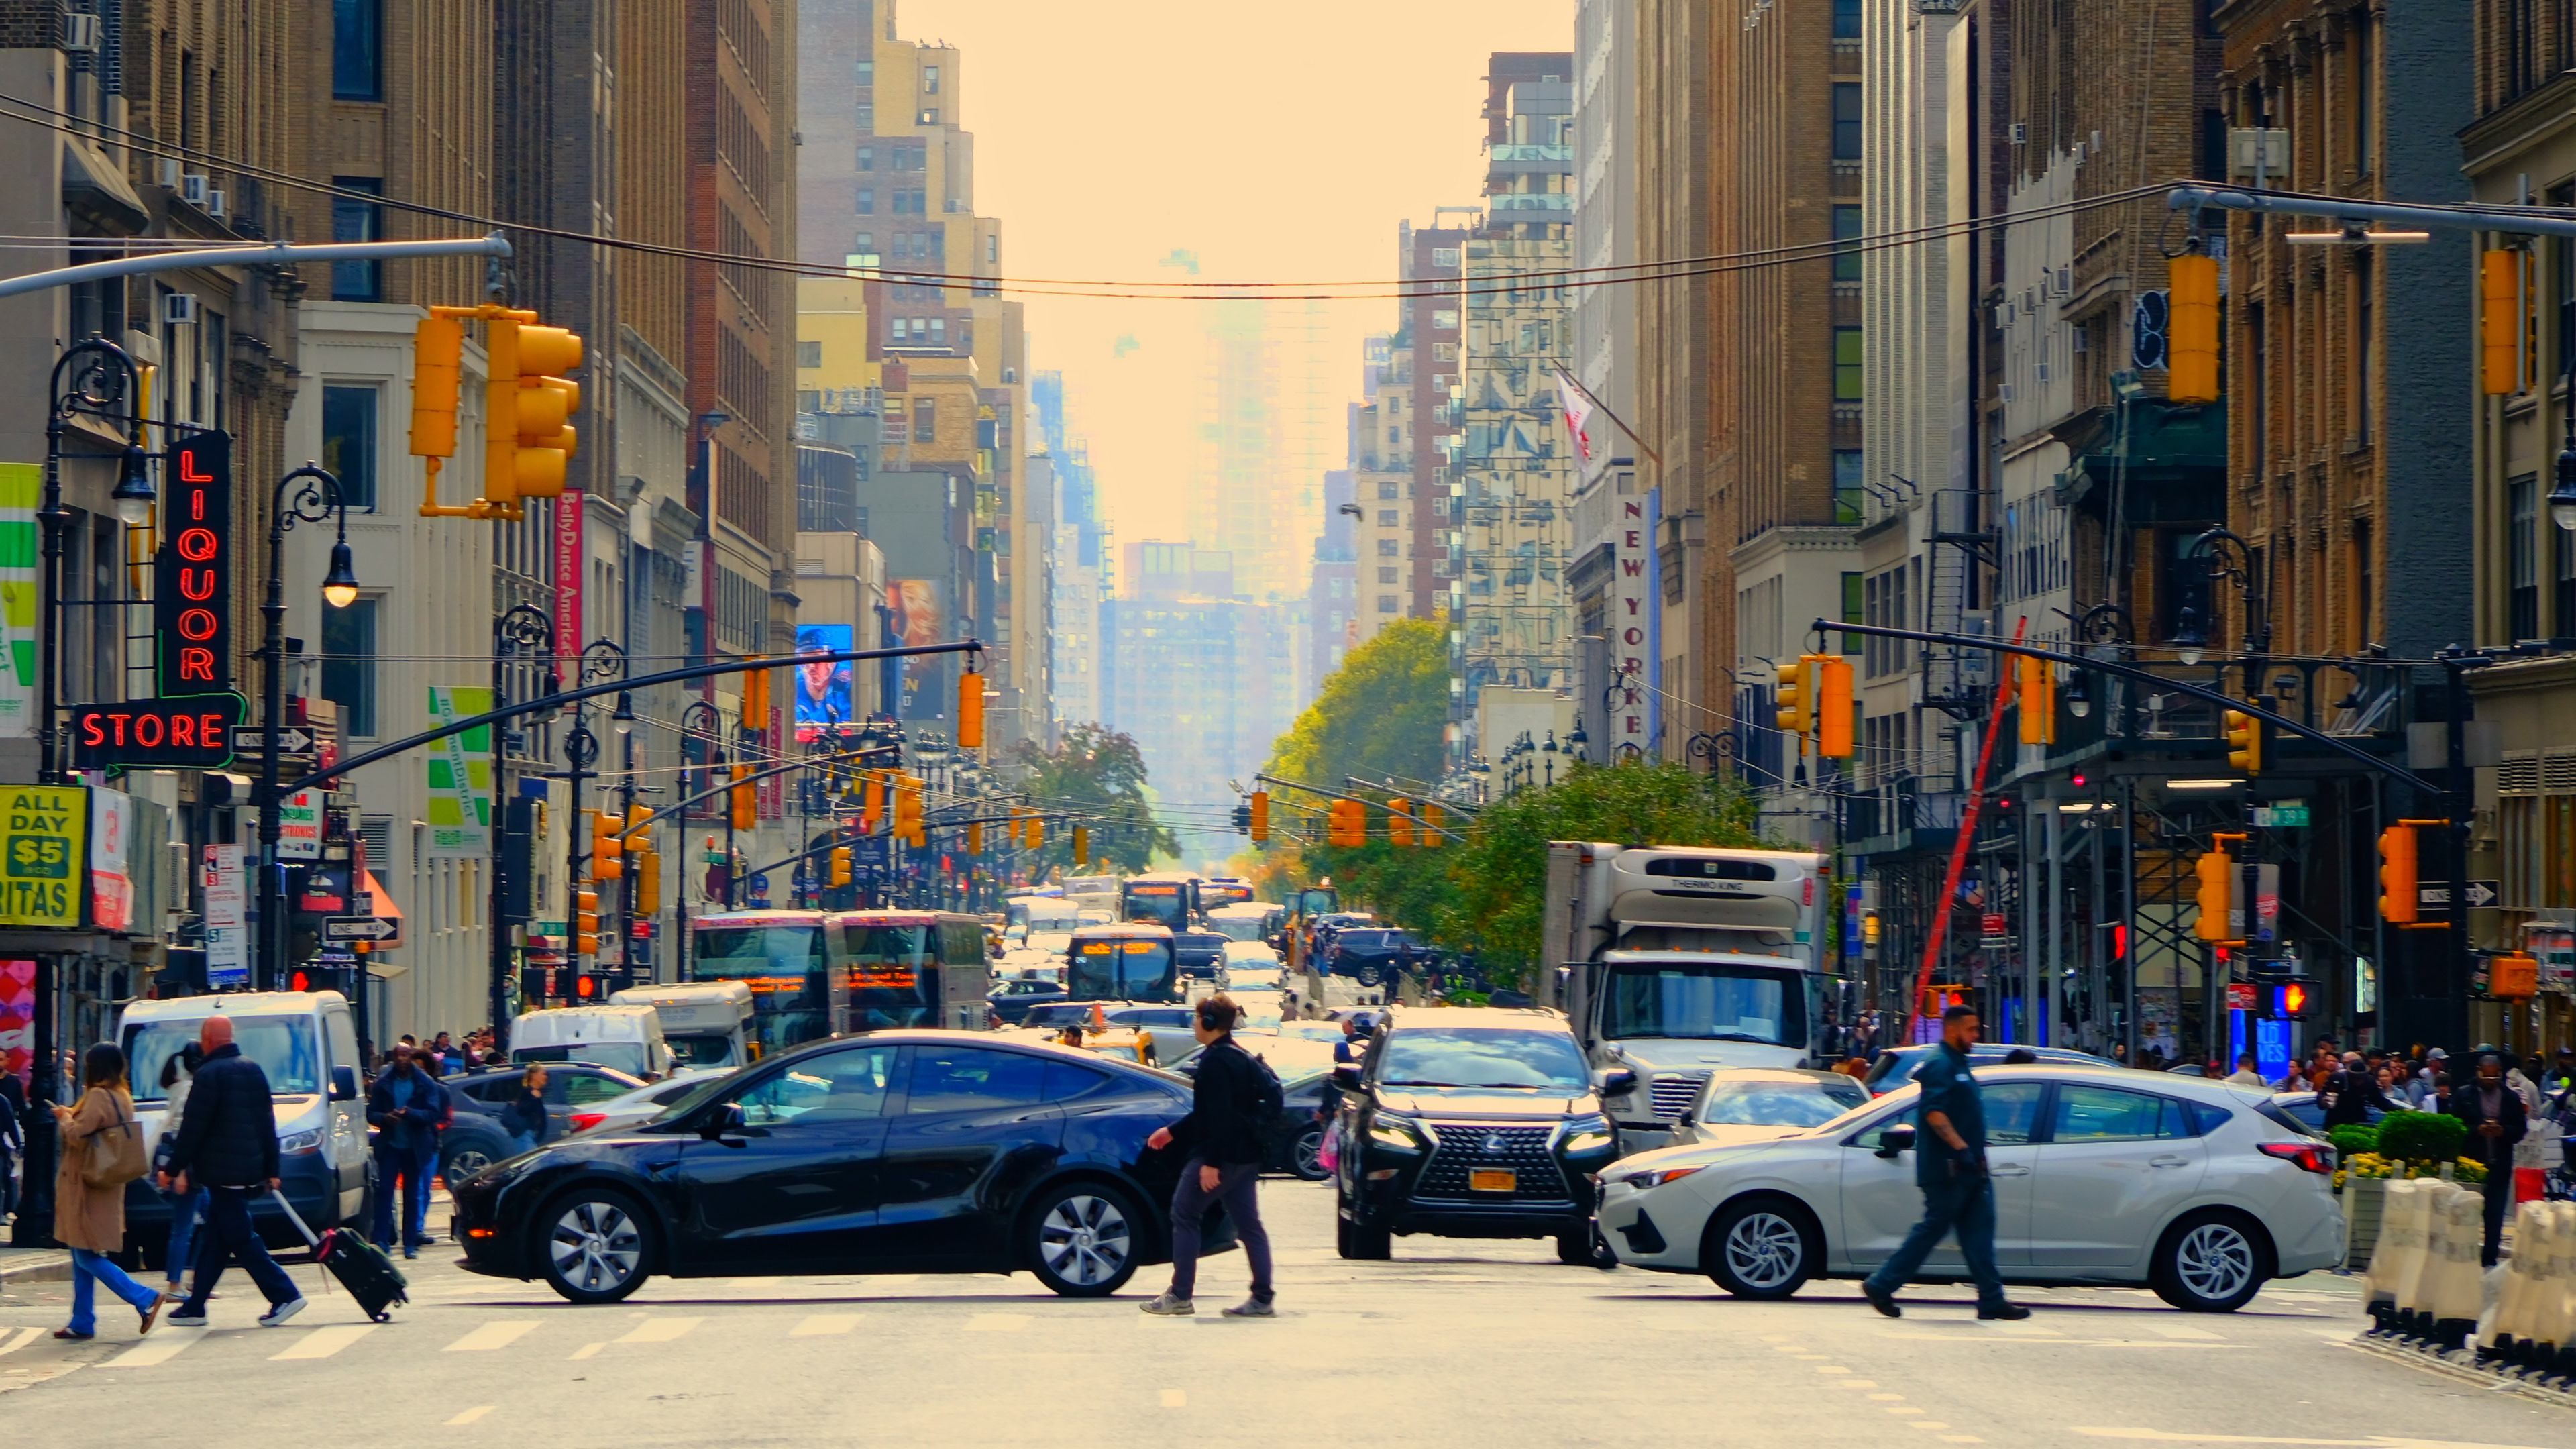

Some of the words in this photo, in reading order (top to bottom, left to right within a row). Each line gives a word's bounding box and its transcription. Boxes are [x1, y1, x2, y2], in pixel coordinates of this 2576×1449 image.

[557, 492, 578, 581] BellyDance
[1623, 502, 1644, 576] NEW
[178, 450, 217, 680] LIQUOR
[560, 584, 577, 651] America
[1624, 597, 1643, 757] YORKE
[83, 713, 223, 747] STORE
[439, 698, 474, 818] #GamentDistrict
[12, 794, 68, 811] ALL
[11, 815, 69, 832] DAY
[14, 839, 64, 865] $5
[0, 881, 66, 917] ITAS
[1672, 879, 1716, 889] THERMO
[1719, 882, 1743, 890] KING
[2427, 890, 2451, 900] ONE
[333, 924, 352, 934] ONE
[366, 924, 386, 933] WAY
